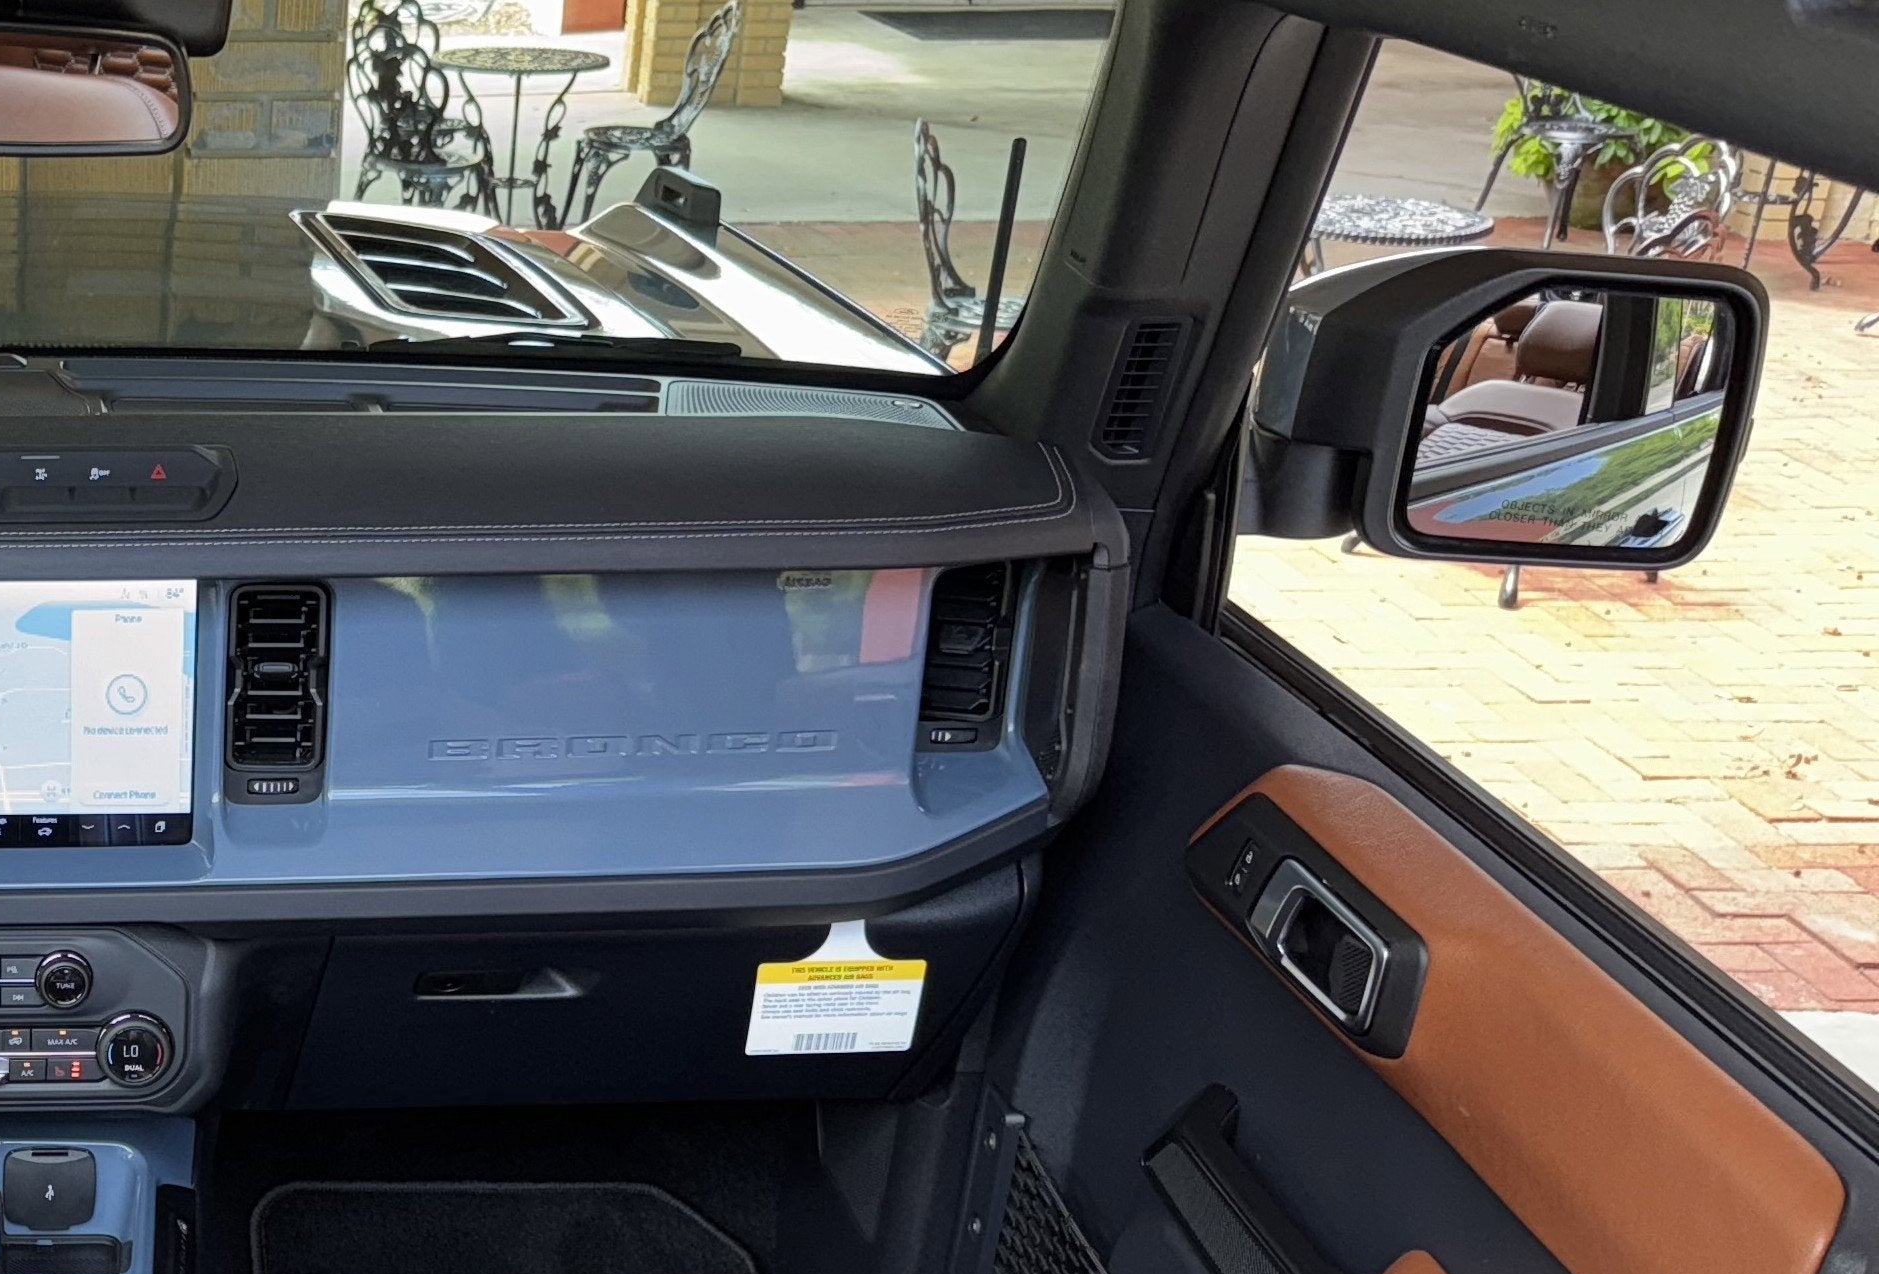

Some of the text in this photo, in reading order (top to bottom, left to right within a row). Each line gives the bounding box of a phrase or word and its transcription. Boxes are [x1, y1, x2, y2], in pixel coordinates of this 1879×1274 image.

[1501, 499, 1556, 514] OBJECTS
[1489, 511, 1535, 526] CLOSER
[427, 729, 838, 762] BRONCO
[123, 1045, 138, 1058] LO
[21, 1069, 34, 1077] A/C
[124, 1064, 144, 1072] DUAL
